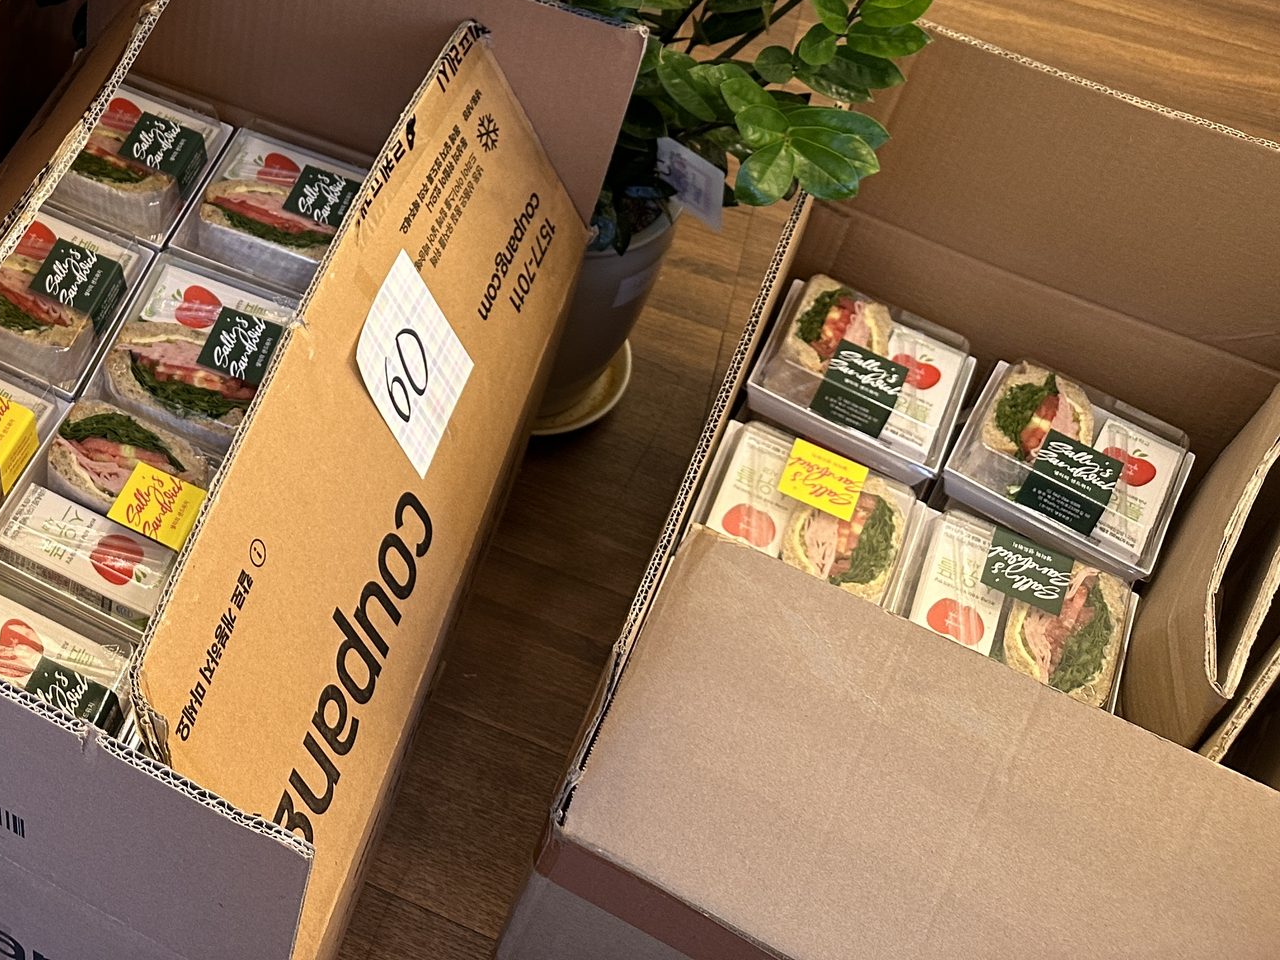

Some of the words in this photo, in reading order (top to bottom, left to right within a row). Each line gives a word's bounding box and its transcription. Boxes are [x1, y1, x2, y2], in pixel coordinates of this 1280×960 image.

[133, 121, 165, 159] Sally's
[298, 175, 329, 214] Sally's
[46, 249, 81, 294] Sally's
[59, 249, 98, 307] Sandwich
[477, 192, 540, 321] coupang.com
[509, 218, 557, 315] 1577-7011
[214, 315, 249, 368] Sally's
[230, 315, 267, 380] Sandwich
[838, 350, 899, 384] Sally's
[385, 328, 430, 423] 60
[1047, 441, 1113, 477] Sally's
[126, 474, 164, 526] Sally's
[791, 471, 851, 507] Sally's
[230, 568, 255, 612] 칼로
[991, 561, 1060, 600] Sally's
[199, 608, 237, 685] 개봉하지
[175, 681, 207, 742] 마세요
